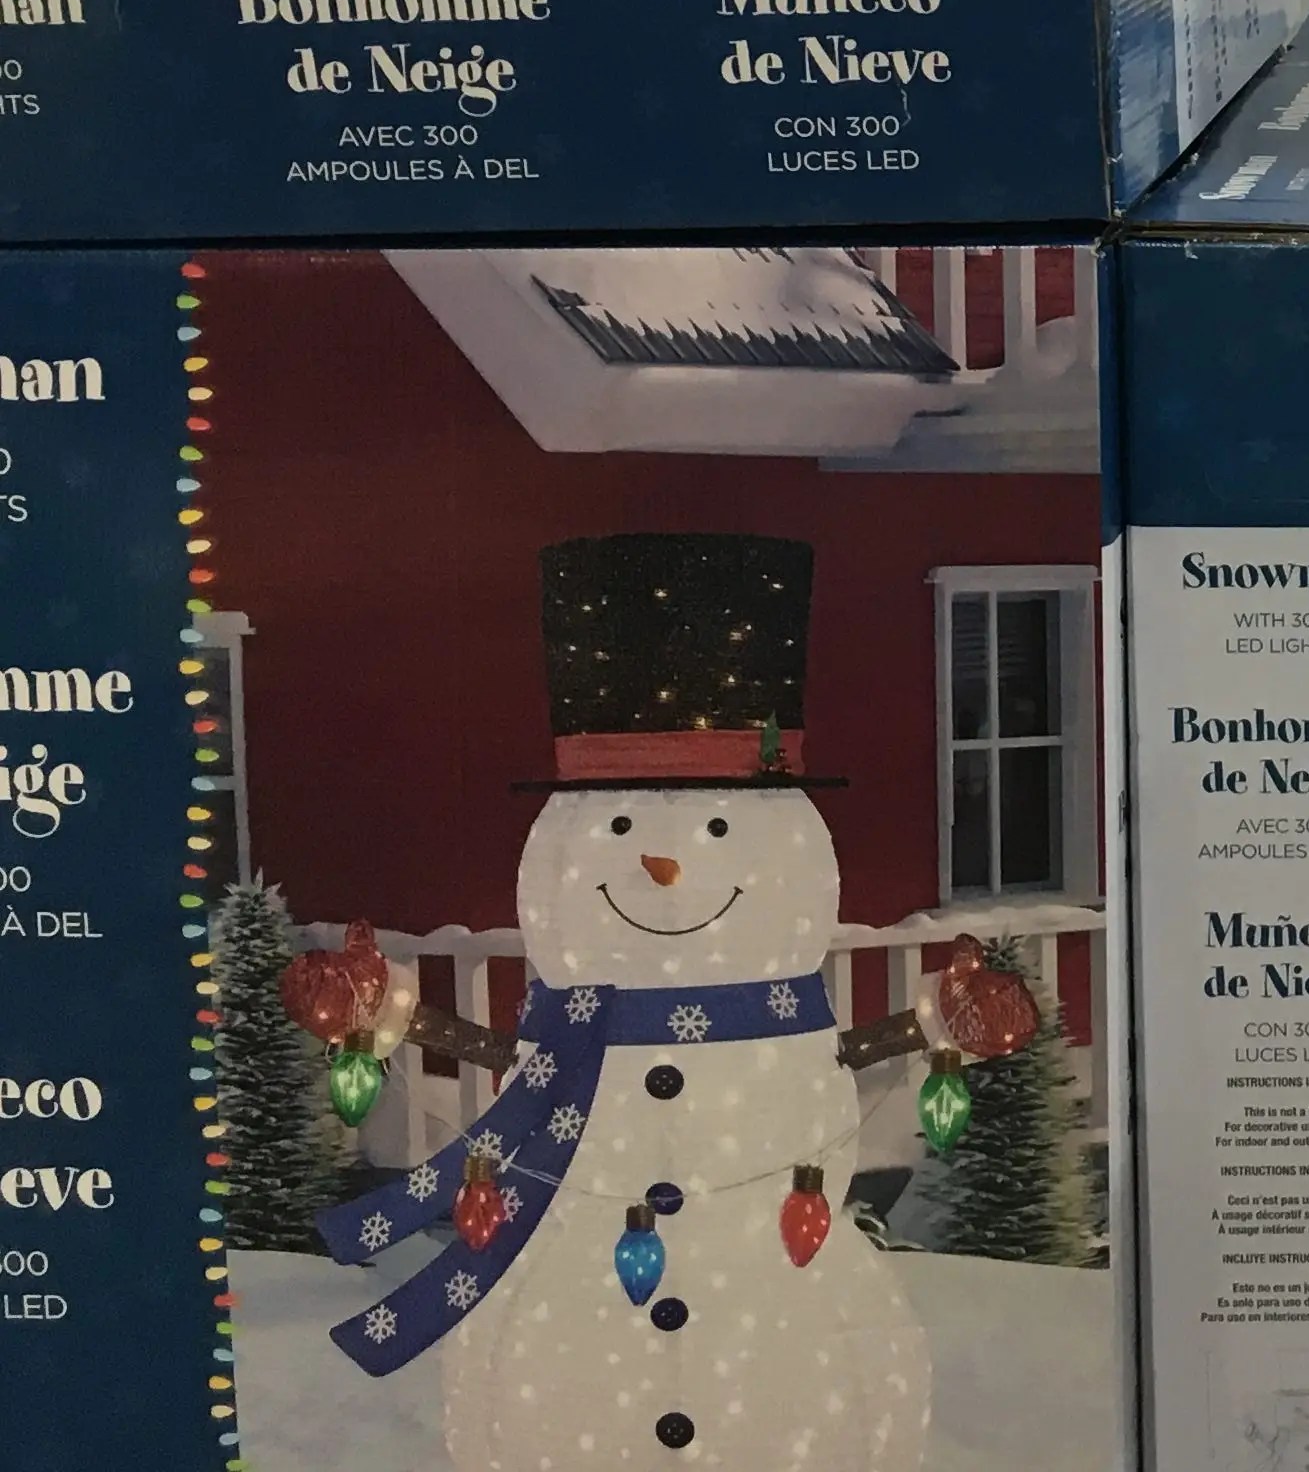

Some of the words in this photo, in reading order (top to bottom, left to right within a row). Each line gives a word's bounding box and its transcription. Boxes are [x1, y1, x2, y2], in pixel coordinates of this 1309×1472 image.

[722, 40, 785, 84] de
[799, 35, 951, 84] Nieve
[288, 48, 351, 93] de
[364, 44, 516, 117] Neige
[775, 117, 835, 137] CON
[846, 116, 899, 136] 300
[339, 126, 414, 146] AVEC
[423, 125, 478, 145] 300
[287, 160, 443, 181] AMPOULES
[454, 155, 474, 179] À
[484, 159, 539, 178] DEL
[768, 151, 857, 171] LUCES
[867, 150, 919, 170] LED
[1234, 613, 1284, 627] WITH
[1226, 638, 1263, 653] LED
[1203, 761, 1247, 793] de
[1236, 819, 1288, 833] AVEC
[1198, 844, 1307, 859] AMPOULES
[1, 905, 26, 936] À
[37, 911, 103, 938] DEL
[1204, 966, 1249, 998] de
[1244, 1023, 1287, 1037] CON
[1236, 1048, 1297, 1062] LUCES
[1227, 1077, 1303, 1088] INSTRUCTIONS
[1244, 1106, 1265, 1117] This
[1268, 1106, 1277, 1117] is
[1280, 1106, 1297, 1117] not
[1300, 1108, 1306, 1117] a
[1224, 1122, 1242, 1132] For
[1244, 1122, 1298, 1132] decorative
[1215, 1136, 1232, 1147] For
[1235, 1136, 1268, 1146] indoor
[1270, 1136, 1290, 1146] and
[1220, 1166, 1297, 1176] INSTRUCTIONS
[1222, 1253, 1266, 1264] INCLUYE
[3, 1294, 68, 1320] LED
